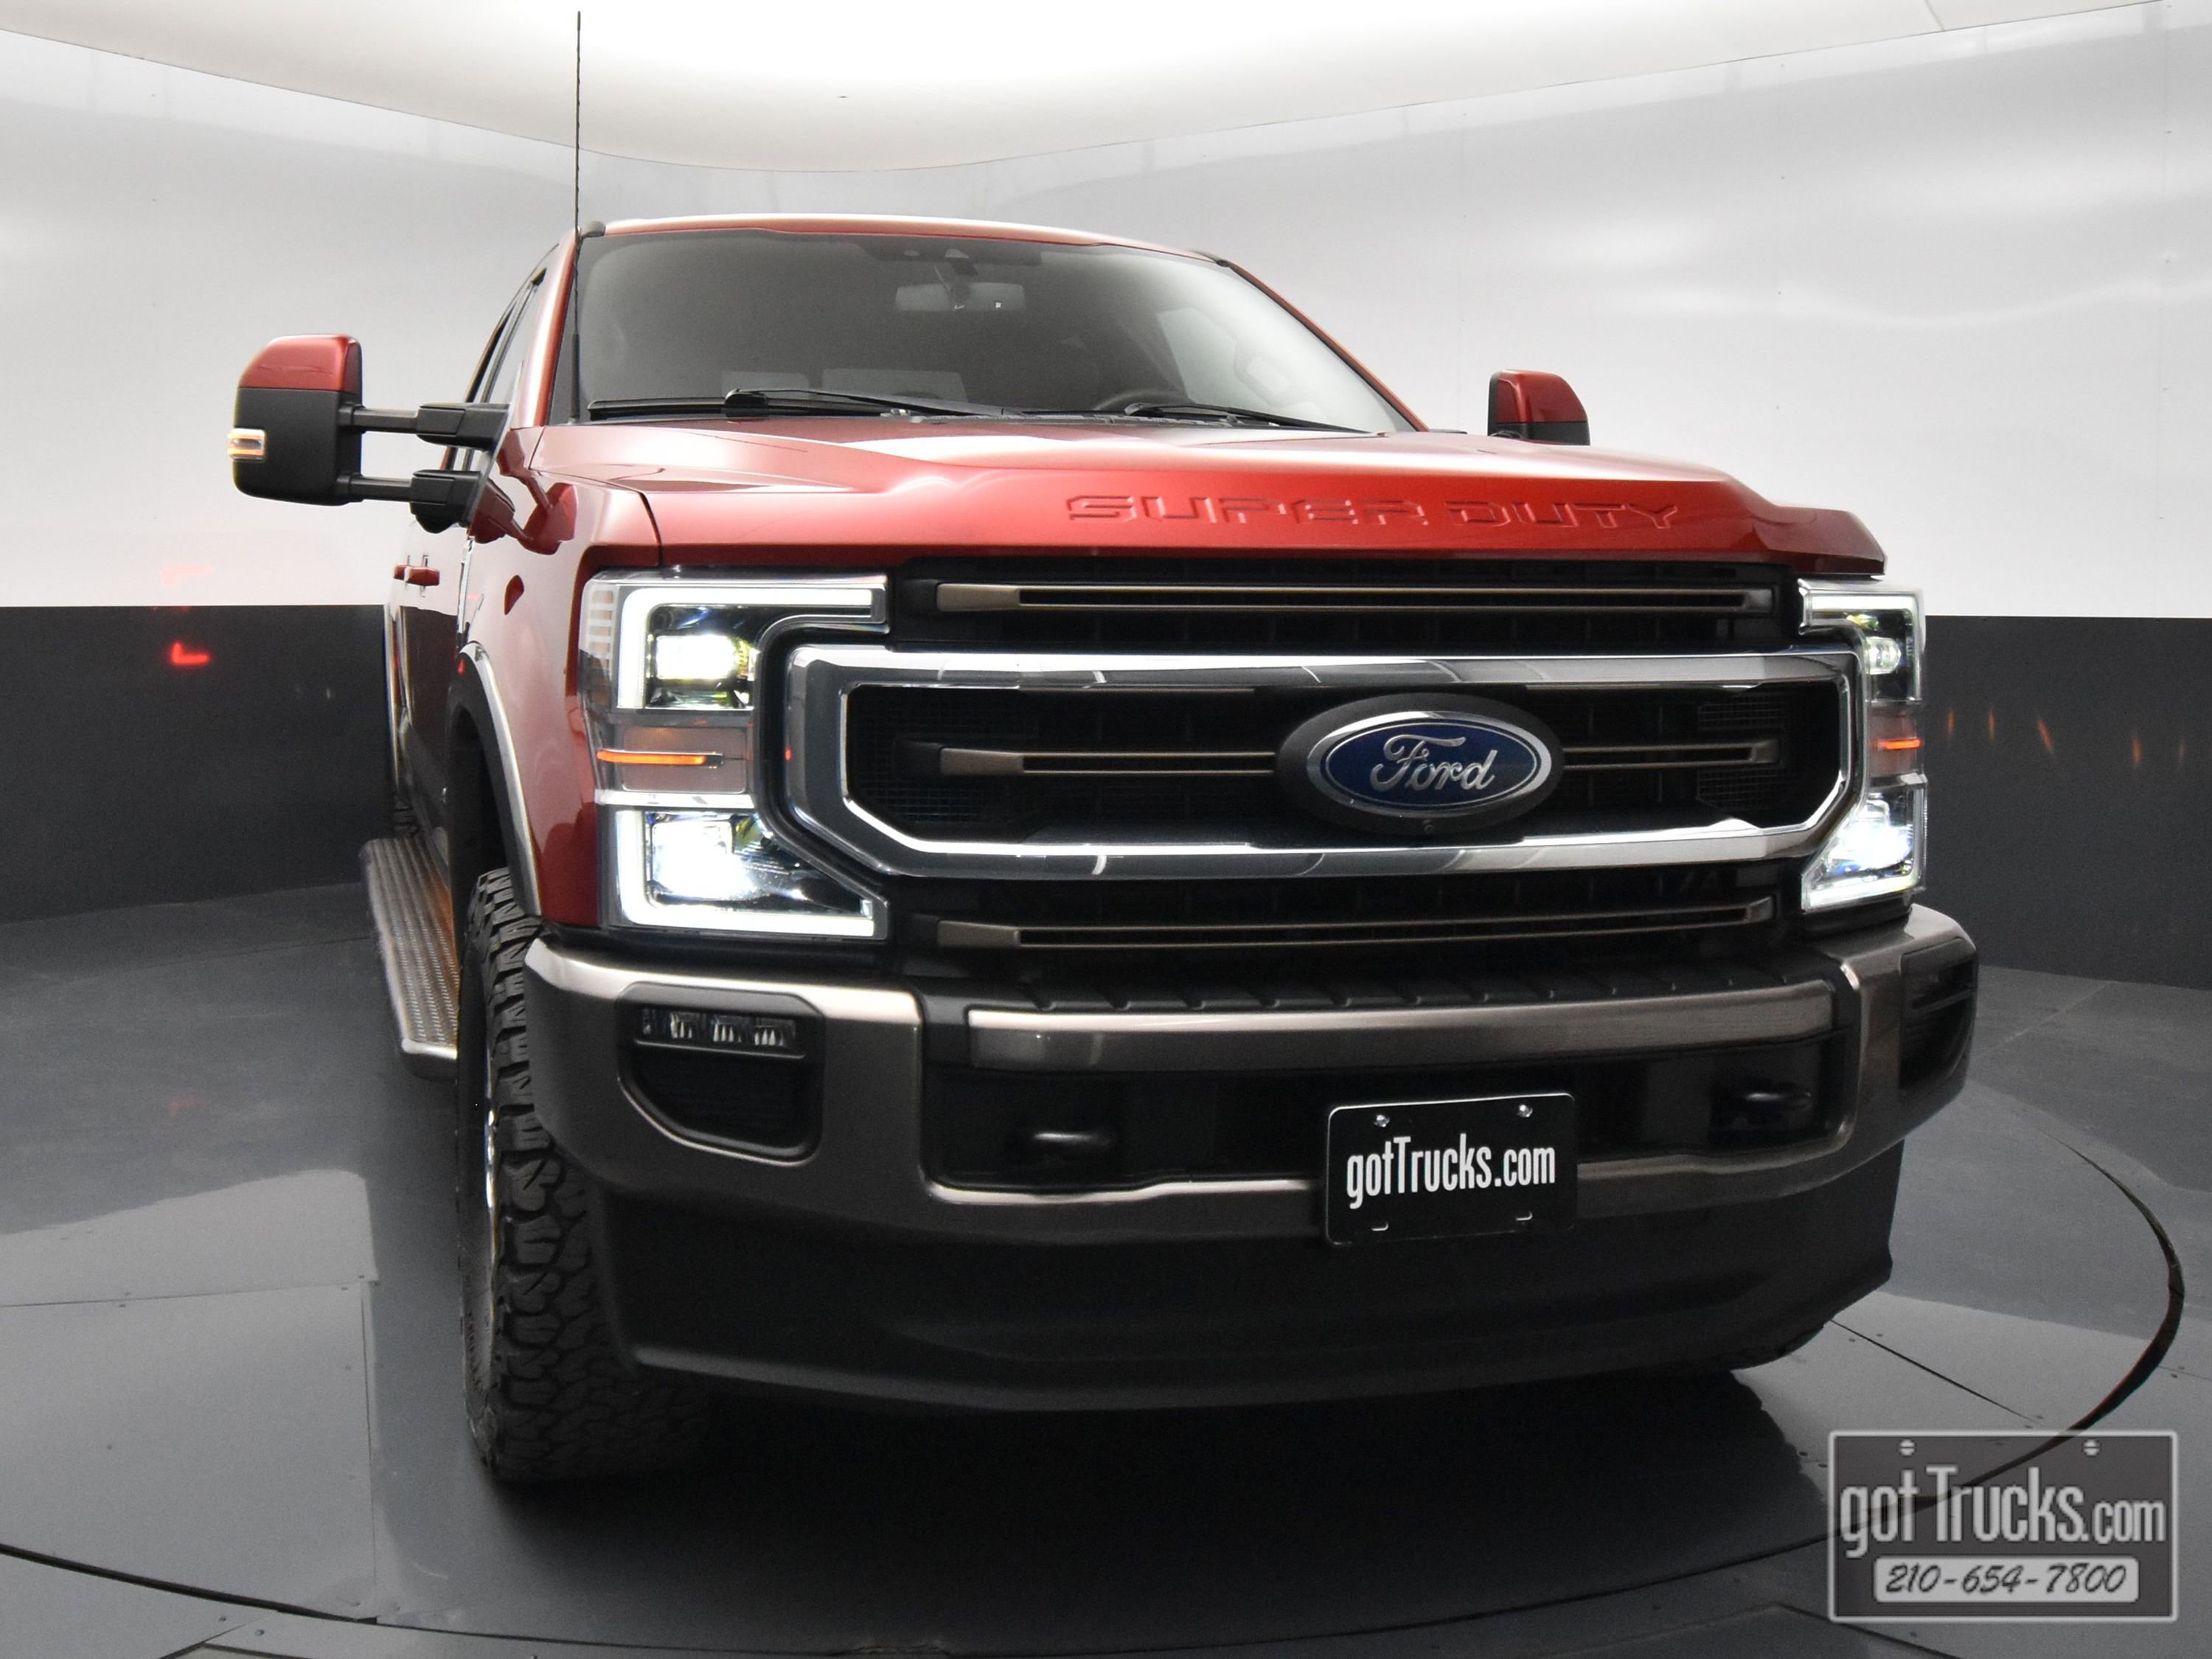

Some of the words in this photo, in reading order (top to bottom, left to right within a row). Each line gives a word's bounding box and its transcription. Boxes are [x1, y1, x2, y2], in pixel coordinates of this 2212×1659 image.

[1067, 495, 1428, 526] SUPER
[1446, 499, 1677, 529] DUTY
[1369, 734, 1498, 792] Ford
[1346, 1133, 1556, 1209] gotTrucks.com
